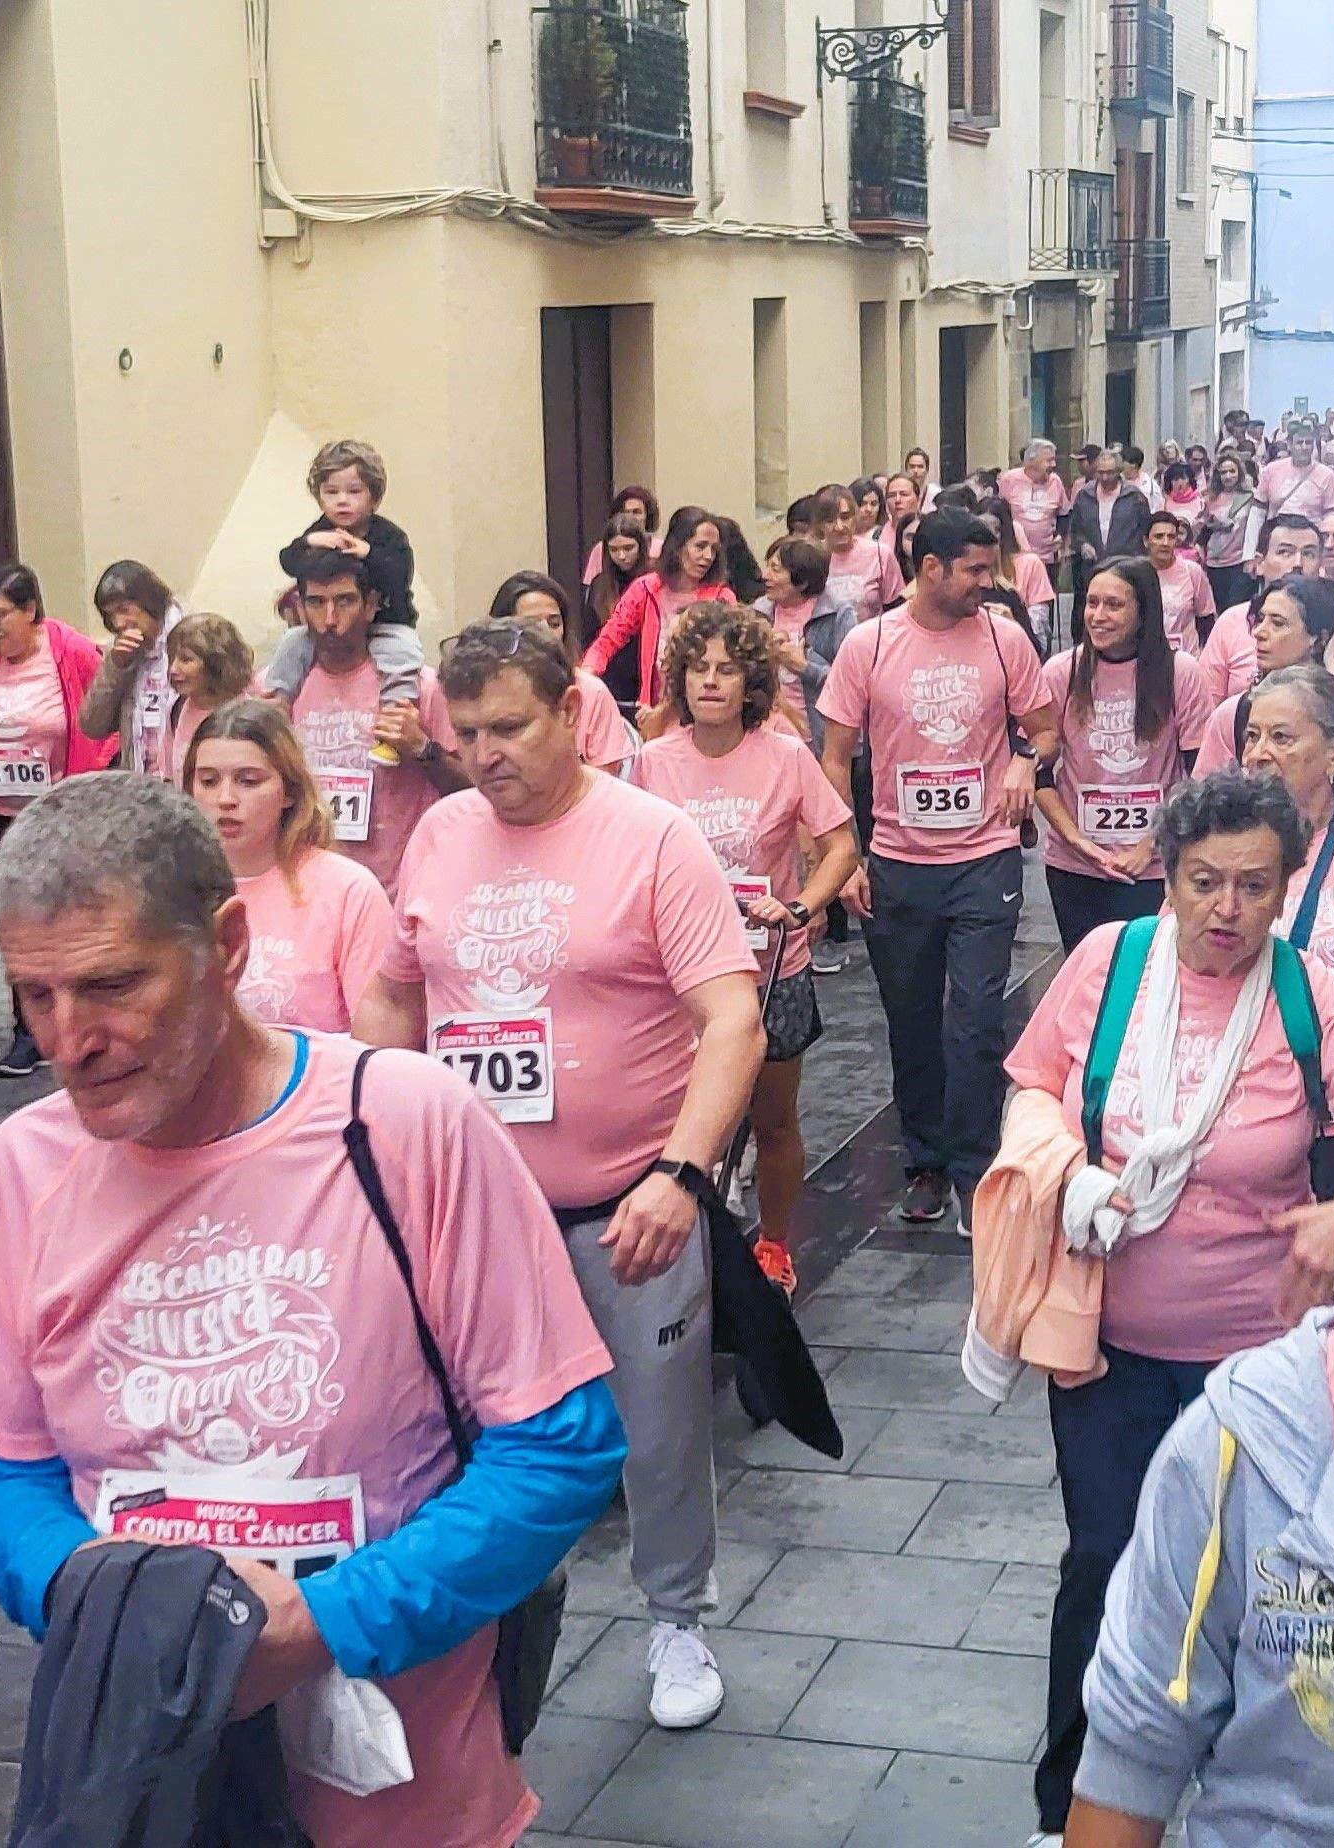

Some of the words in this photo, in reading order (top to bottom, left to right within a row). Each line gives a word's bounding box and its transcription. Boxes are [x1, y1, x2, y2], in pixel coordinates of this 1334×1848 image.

[916, 787, 970, 811] 936
[1095, 807, 1149, 830] 223
[163, 1244, 308, 1301] CARRERA
[127, 1284, 272, 1357] HUESCA
[196, 1503, 260, 1522] HUESCA
[124, 1516, 212, 1542] CONTRA
[216, 1522, 241, 1545] EL
[245, 1519, 342, 1545] CÁNCER
